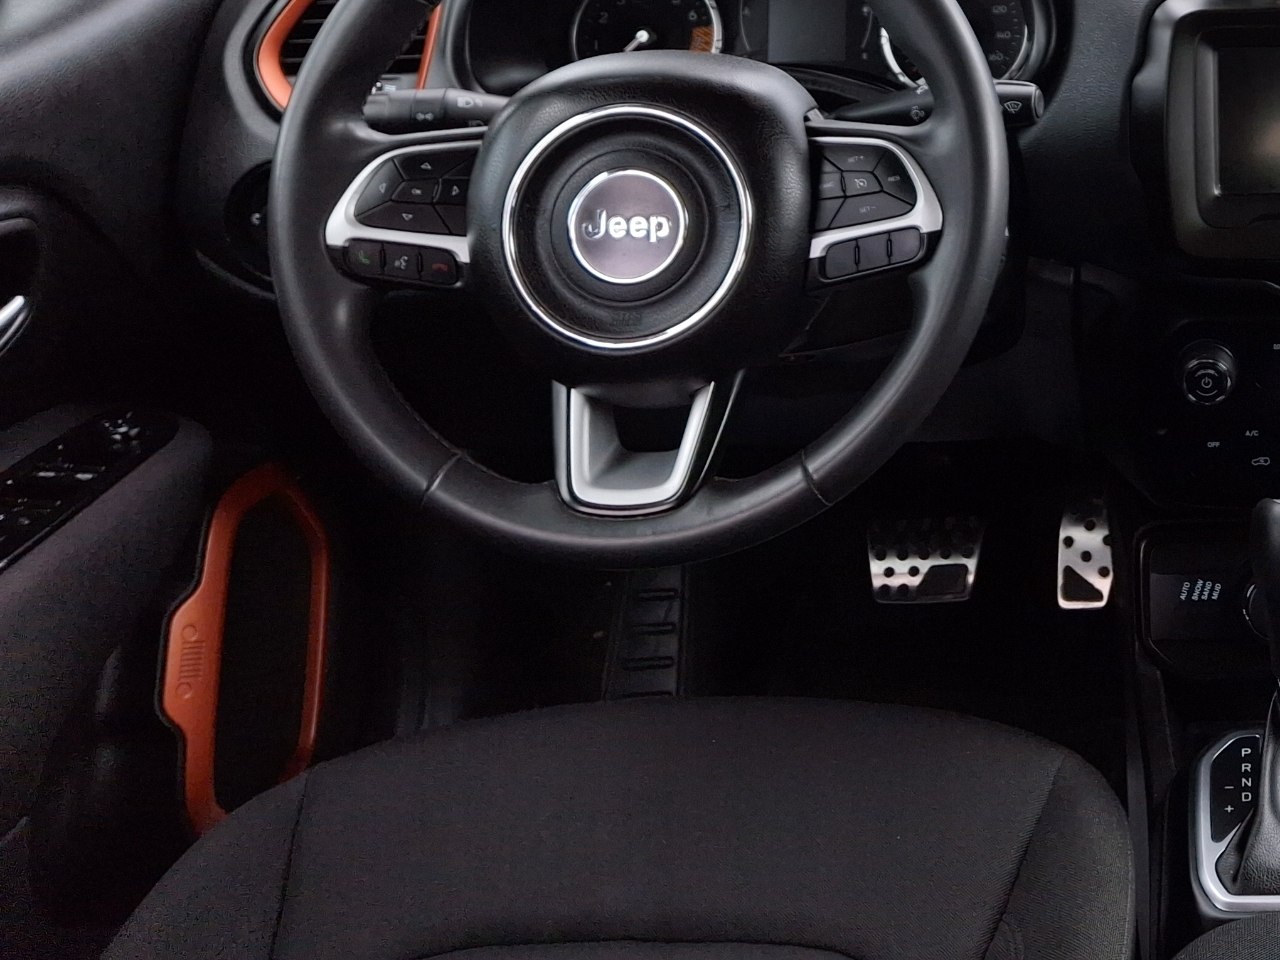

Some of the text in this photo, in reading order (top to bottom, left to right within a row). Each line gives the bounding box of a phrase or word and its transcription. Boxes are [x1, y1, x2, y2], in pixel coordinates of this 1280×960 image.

[688, 9, 698, 20] 6
[582, 209, 670, 243] Jeep
[1244, 429, 1260, 437] A/C
[1179, 581, 1191, 601] AUTO
[1191, 578, 1204, 601] SNOW
[1201, 581, 1213, 601] SAND
[1211, 583, 1222, 600] MUD
[1241, 747, 1252, 758] P
[1241, 763, 1252, 773] R
[1241, 777, 1252, 787] N
[1241, 792, 1252, 802] D
